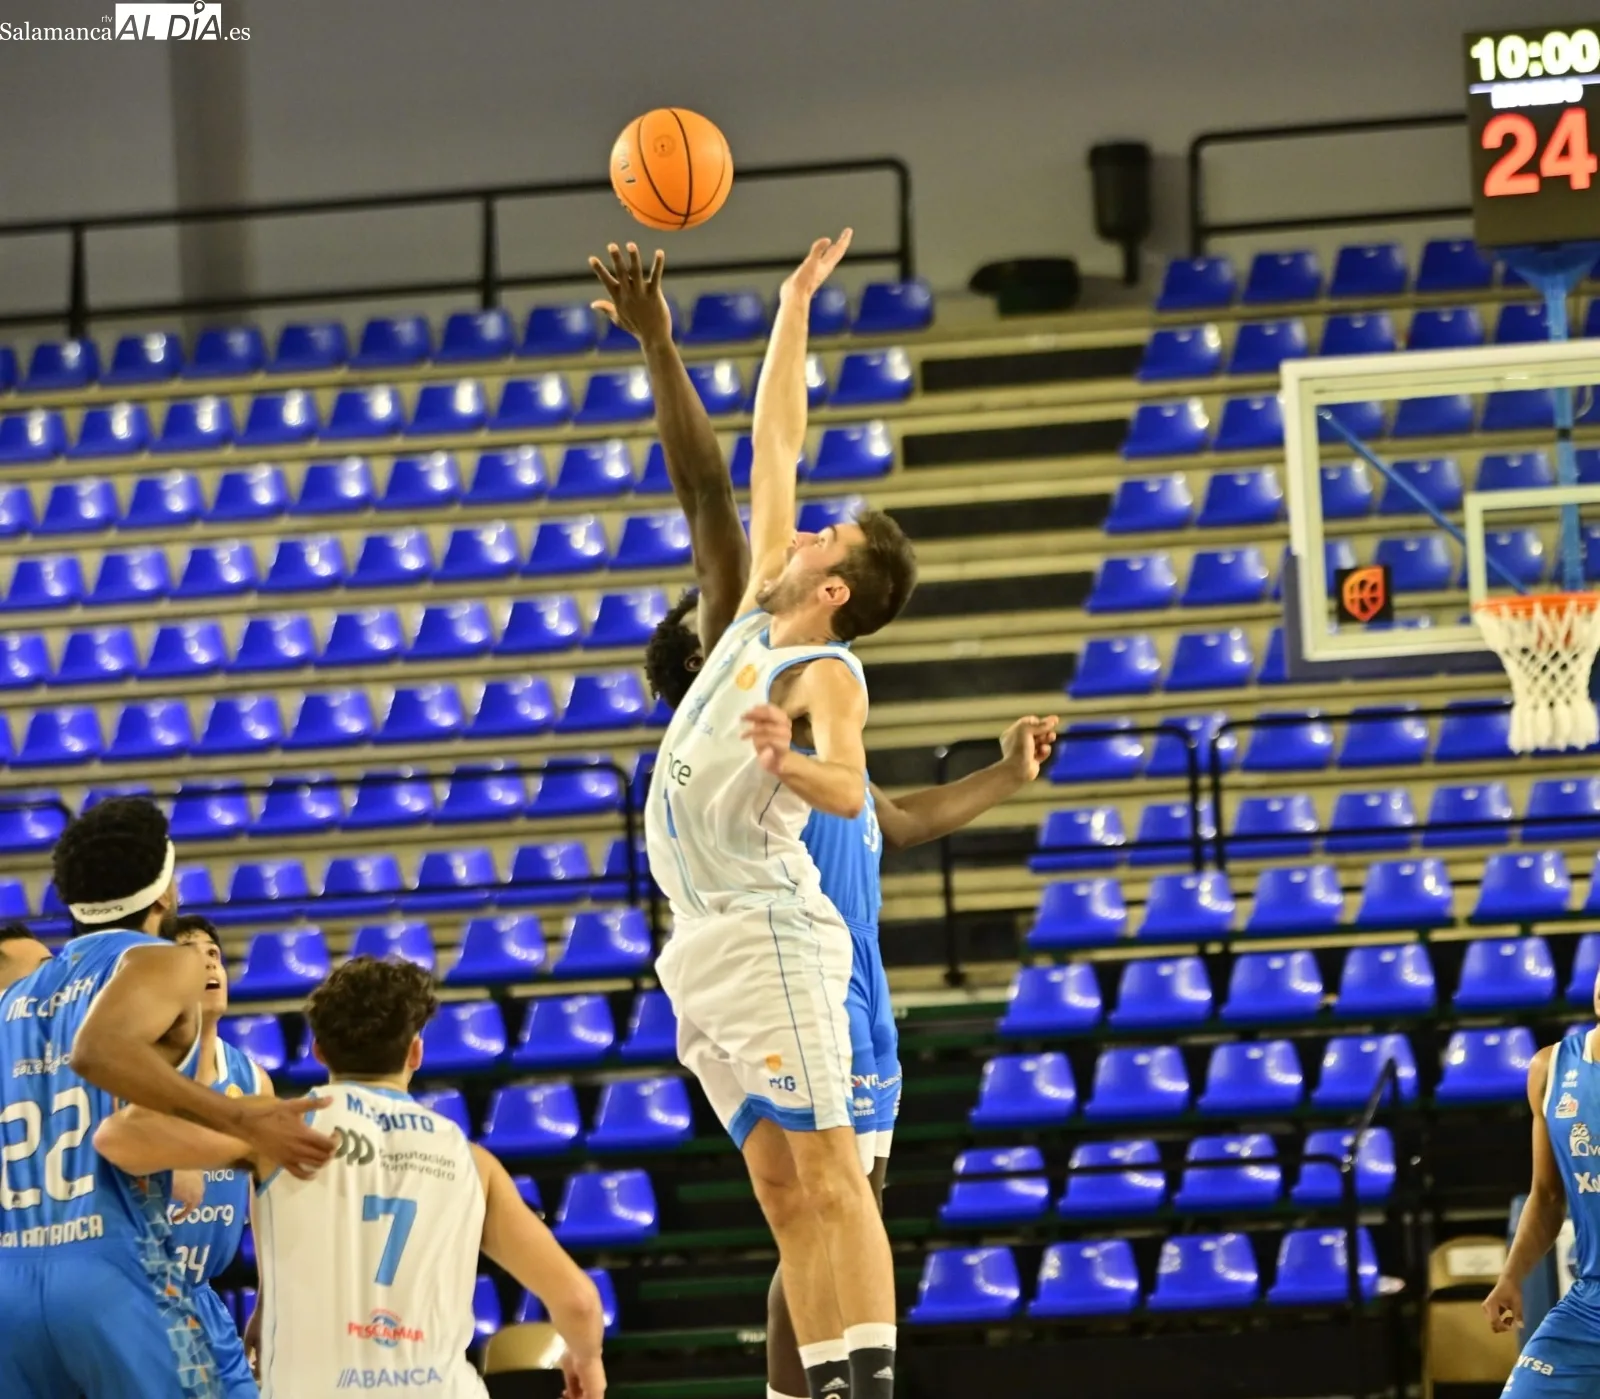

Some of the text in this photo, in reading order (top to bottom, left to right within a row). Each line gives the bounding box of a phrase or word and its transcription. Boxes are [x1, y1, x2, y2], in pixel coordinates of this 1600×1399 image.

[1470, 29, 1600, 81] 10:00
[1481, 106, 1598, 197] 24
[0, 1086, 95, 1211] 22
[362, 1194, 418, 1287] 7
